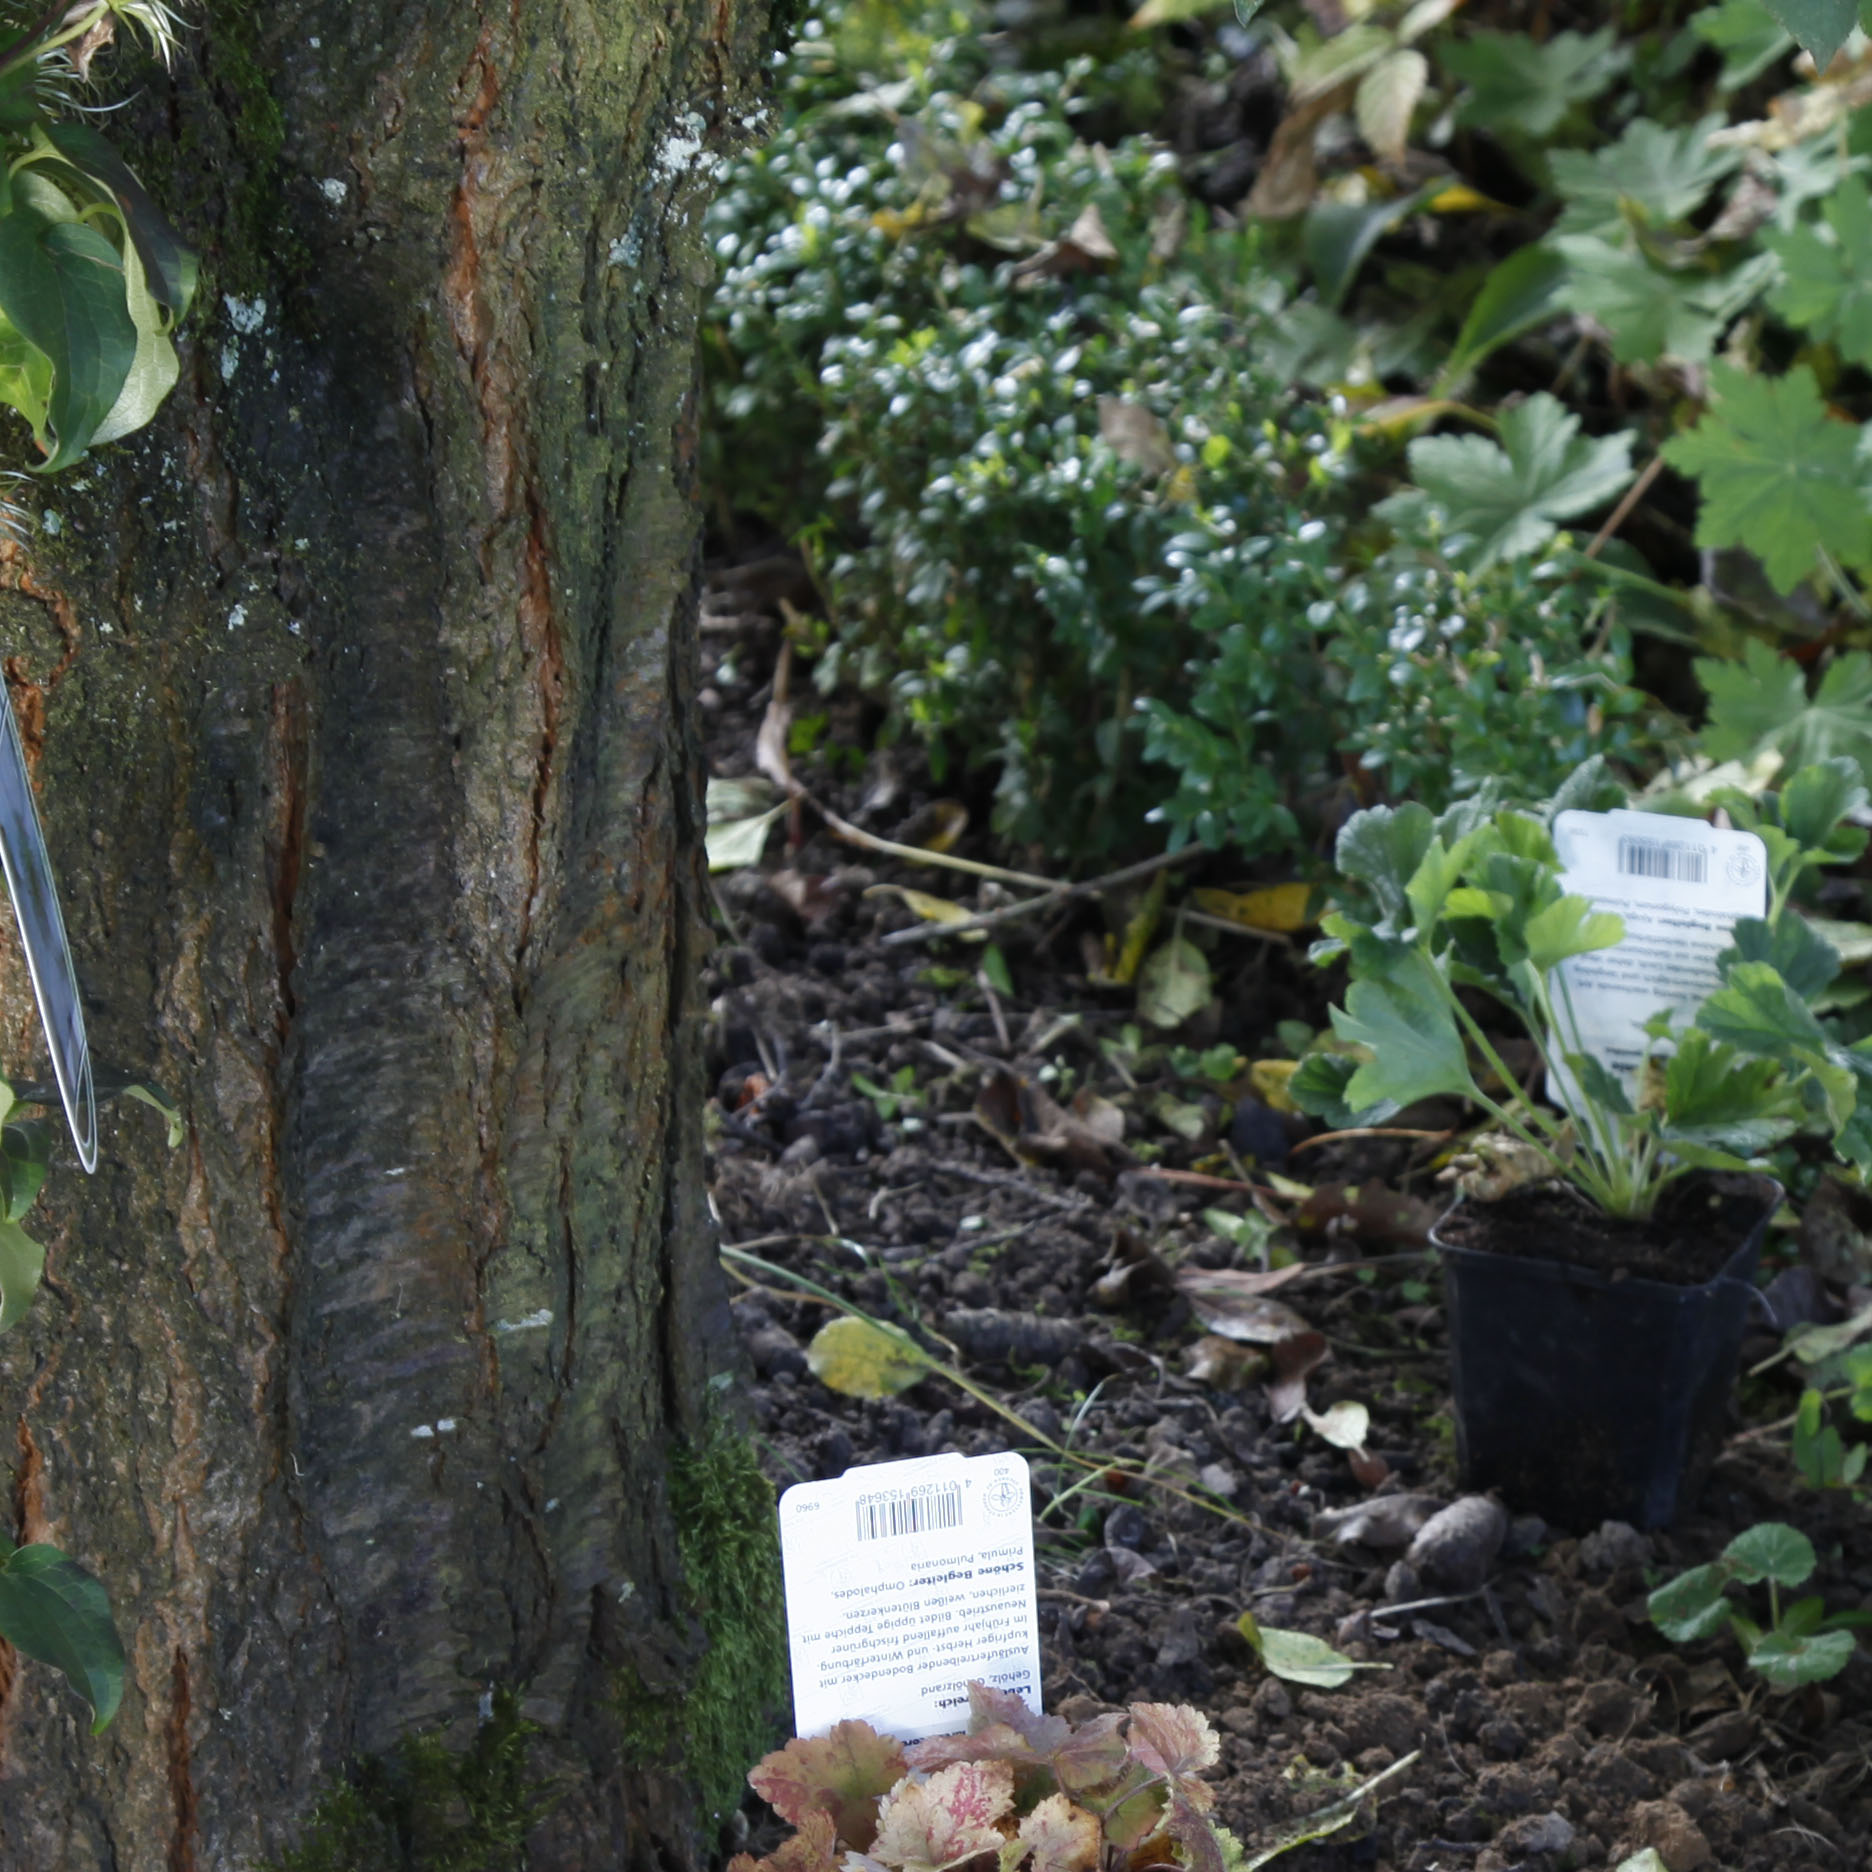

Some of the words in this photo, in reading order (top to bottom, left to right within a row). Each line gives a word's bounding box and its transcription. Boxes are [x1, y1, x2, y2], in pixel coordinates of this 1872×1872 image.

[909, 1553, 974, 1573] Pulmonaria
[977, 1544, 1023, 1562] Primula,
[908, 1567, 972, 1589] Begleiter:
[977, 1560, 1024, 1578] Schöne
[830, 1578, 905, 1602] Omphalodes,
[968, 1582, 1025, 1602] zierlichen,
[841, 1599, 920, 1623] Blütenkerzen.
[923, 1592, 965, 1610] weißen
[955, 1598, 1026, 1619] Neuaustrieb.
[876, 1614, 916, 1632] üppige
[919, 1610, 952, 1625] Bildet
[962, 1614, 1010, 1634] Frühjahr
[801, 1632, 820, 1645] mit
[823, 1621, 873, 1641] Teppiche
[902, 1624, 960, 1644] auffallend
[975, 1627, 1028, 1647] kupfriger
[831, 1632, 898, 1656] frischgrüner
[906, 1645, 929, 1658] und
[931, 1638, 972, 1654] Herbst-
[816, 1647, 903, 1674] Winterfärbung.
[916, 1644, 1029, 1672] Ausläufertreibender
[818, 1677, 837, 1689] mit
[841, 1664, 913, 1685] Bodendecker
[988, 1668, 1031, 1686] Gehölz,
